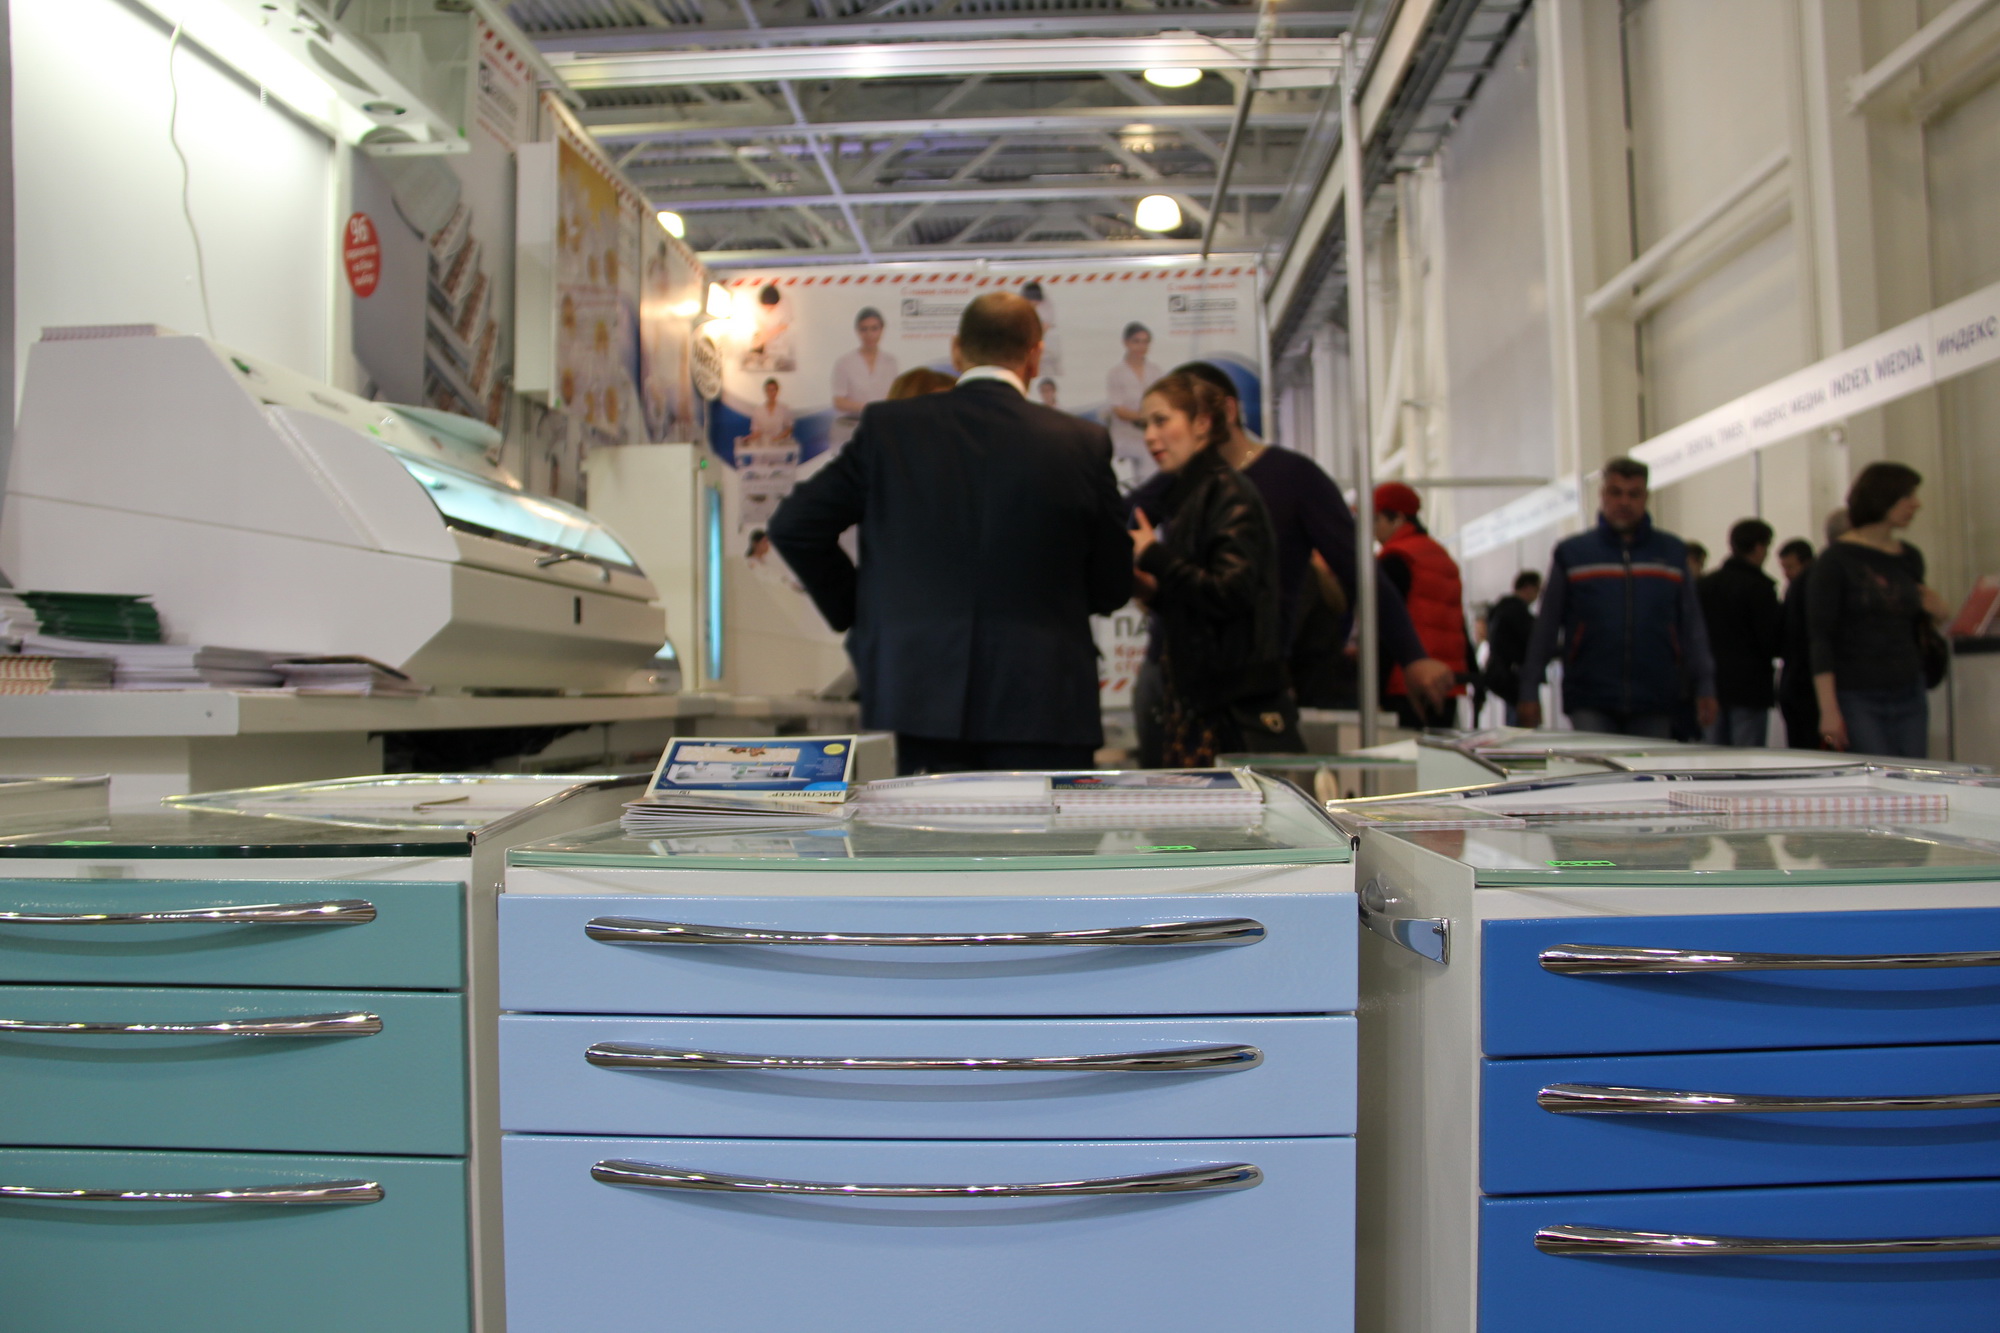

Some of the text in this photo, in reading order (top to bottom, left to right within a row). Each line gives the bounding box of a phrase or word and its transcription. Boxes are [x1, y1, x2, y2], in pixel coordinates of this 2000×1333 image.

[1937, 315, 1998, 355] ИНДЕКС
[1830, 343, 1924, 398] INDEX MEDIA
